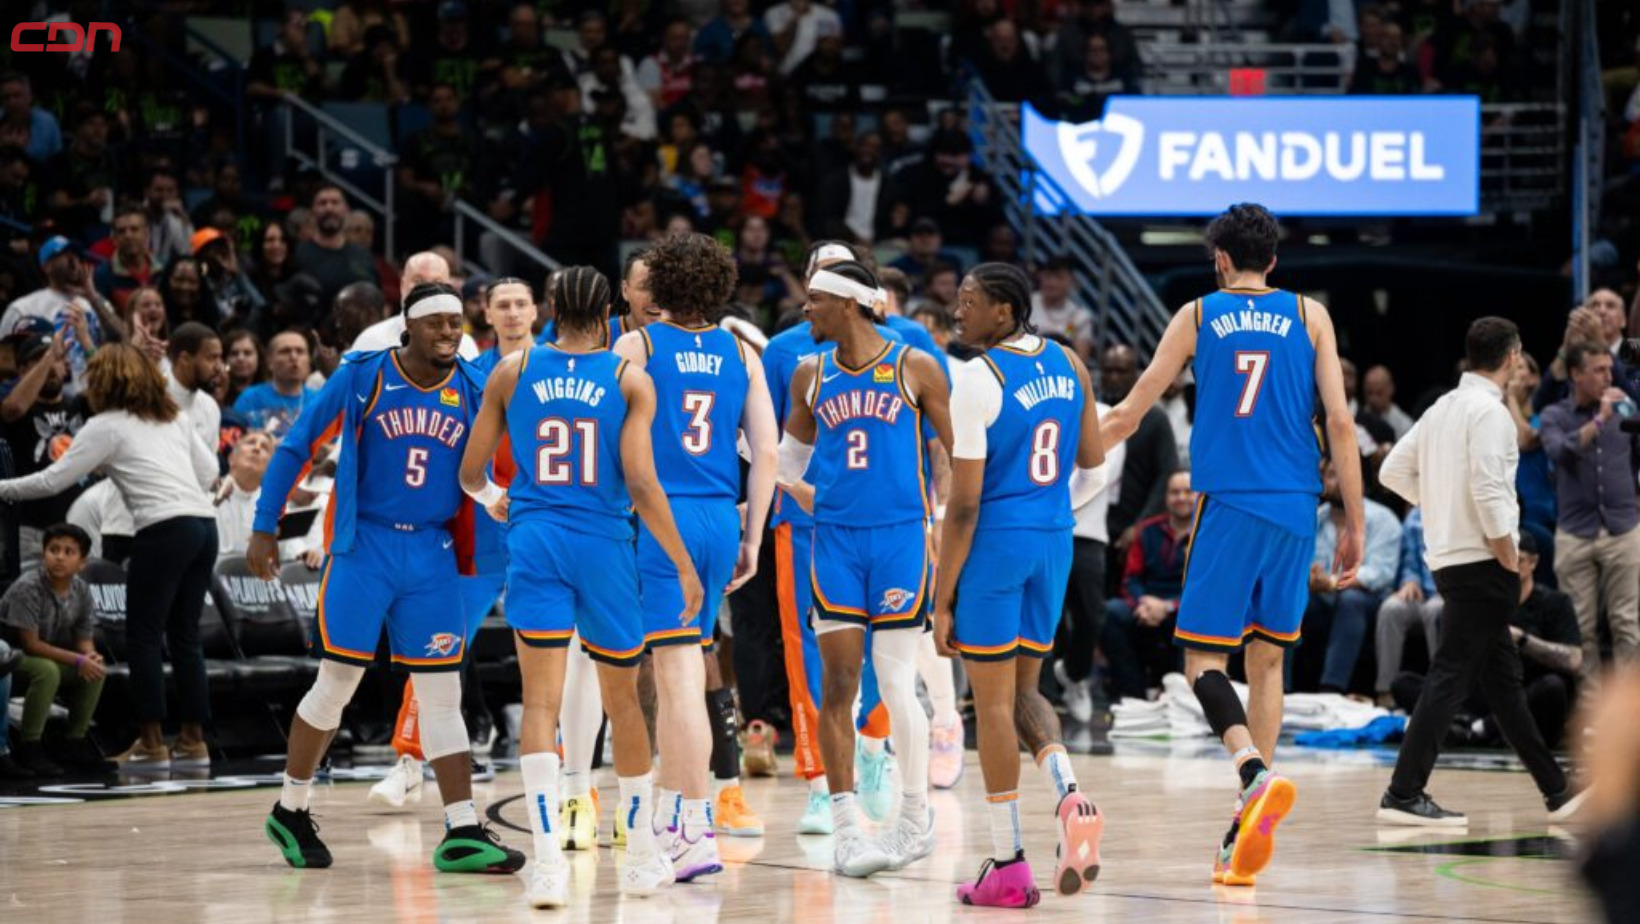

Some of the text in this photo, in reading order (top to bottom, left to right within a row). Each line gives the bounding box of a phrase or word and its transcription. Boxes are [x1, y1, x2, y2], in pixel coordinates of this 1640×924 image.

[1158, 131, 1445, 182] FANDUEL
[1210, 310, 1292, 339] HOLMGREN
[674, 352, 723, 376] GIDDEY
[1235, 350, 1270, 417] 7
[532, 377, 606, 407] WIGGINS
[817, 389, 903, 430] THUNDER
[1013, 375, 1075, 411] WILLIAMS
[376, 407, 465, 448] THUNDER
[682, 390, 715, 457] 3
[405, 447, 429, 488] 5
[536, 415, 599, 487] 21
[847, 428, 868, 469] 2
[1029, 418, 1060, 486] 8
